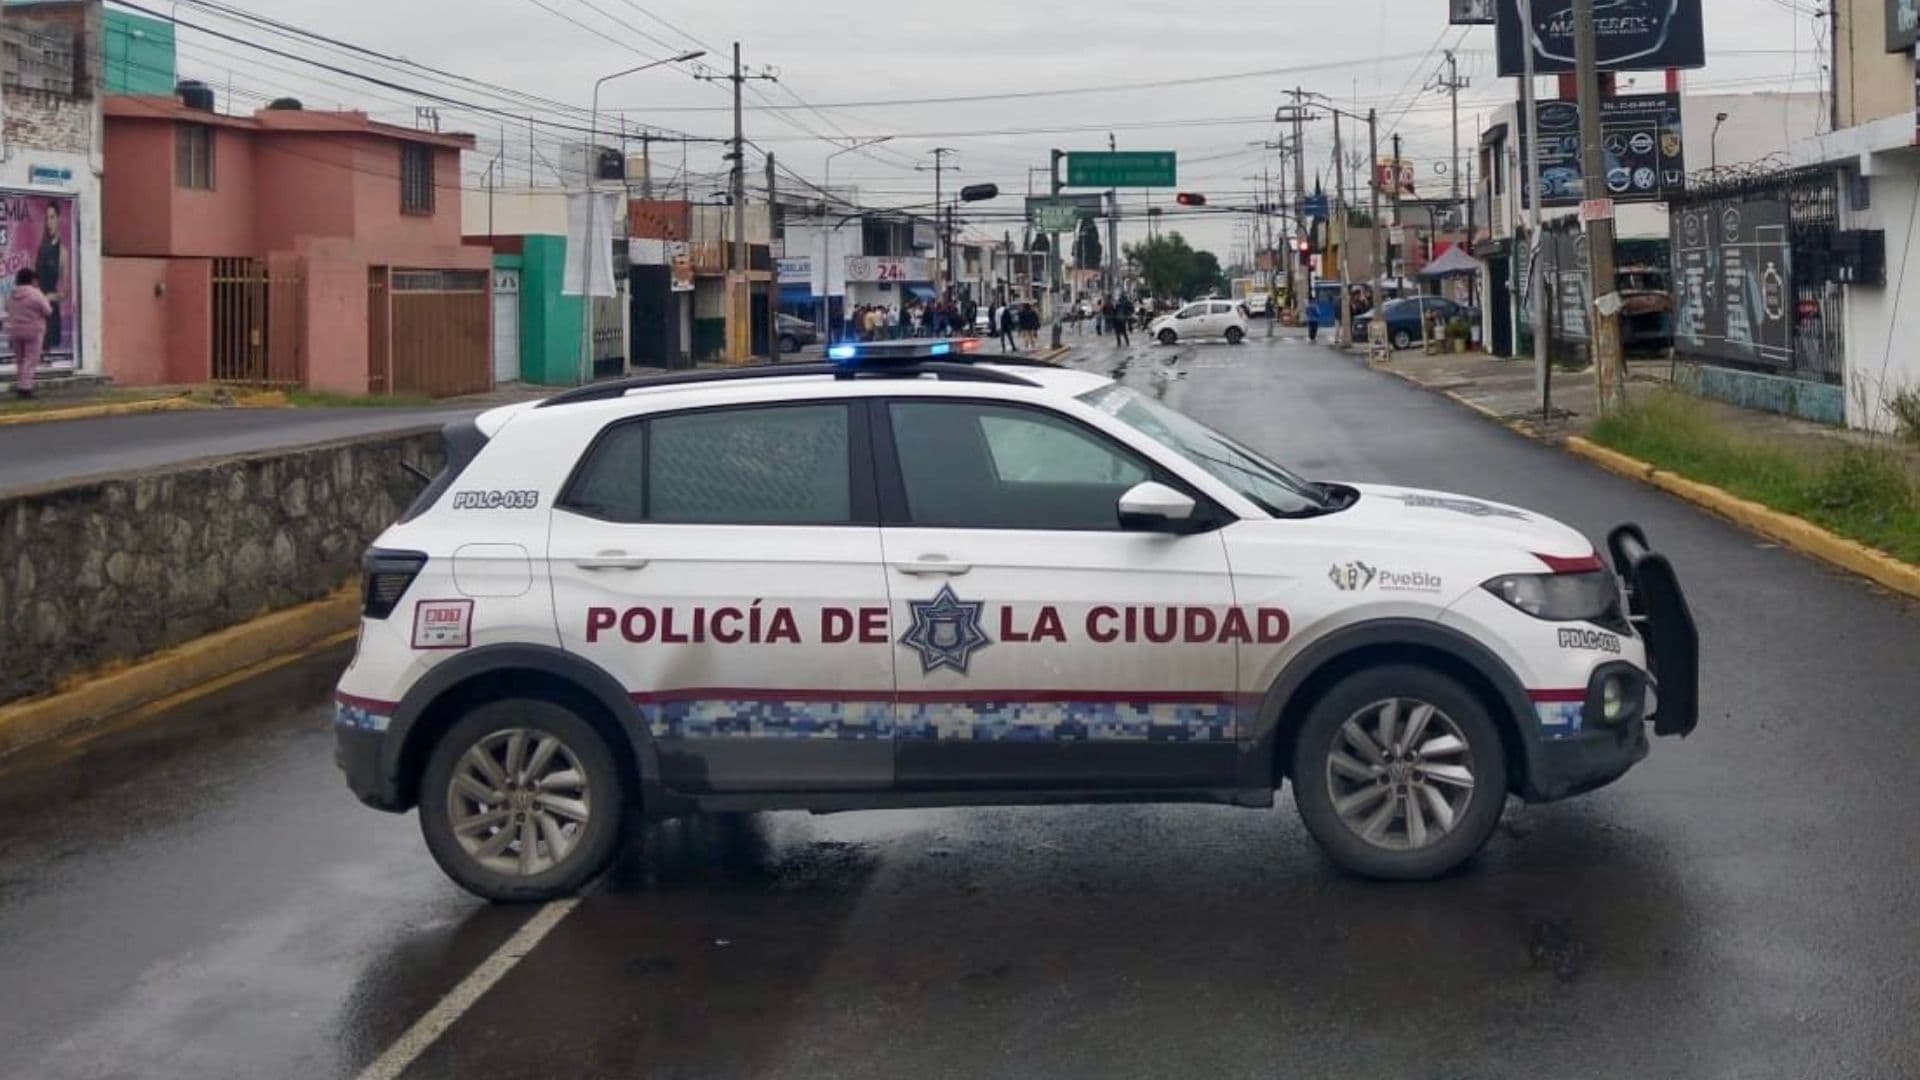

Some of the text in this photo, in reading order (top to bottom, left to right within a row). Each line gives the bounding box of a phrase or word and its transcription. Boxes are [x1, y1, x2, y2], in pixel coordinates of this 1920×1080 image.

[453, 490, 538, 509] PDLC-035
[585, 598, 1291, 644] POLICÍA DE LA CIUDAD
